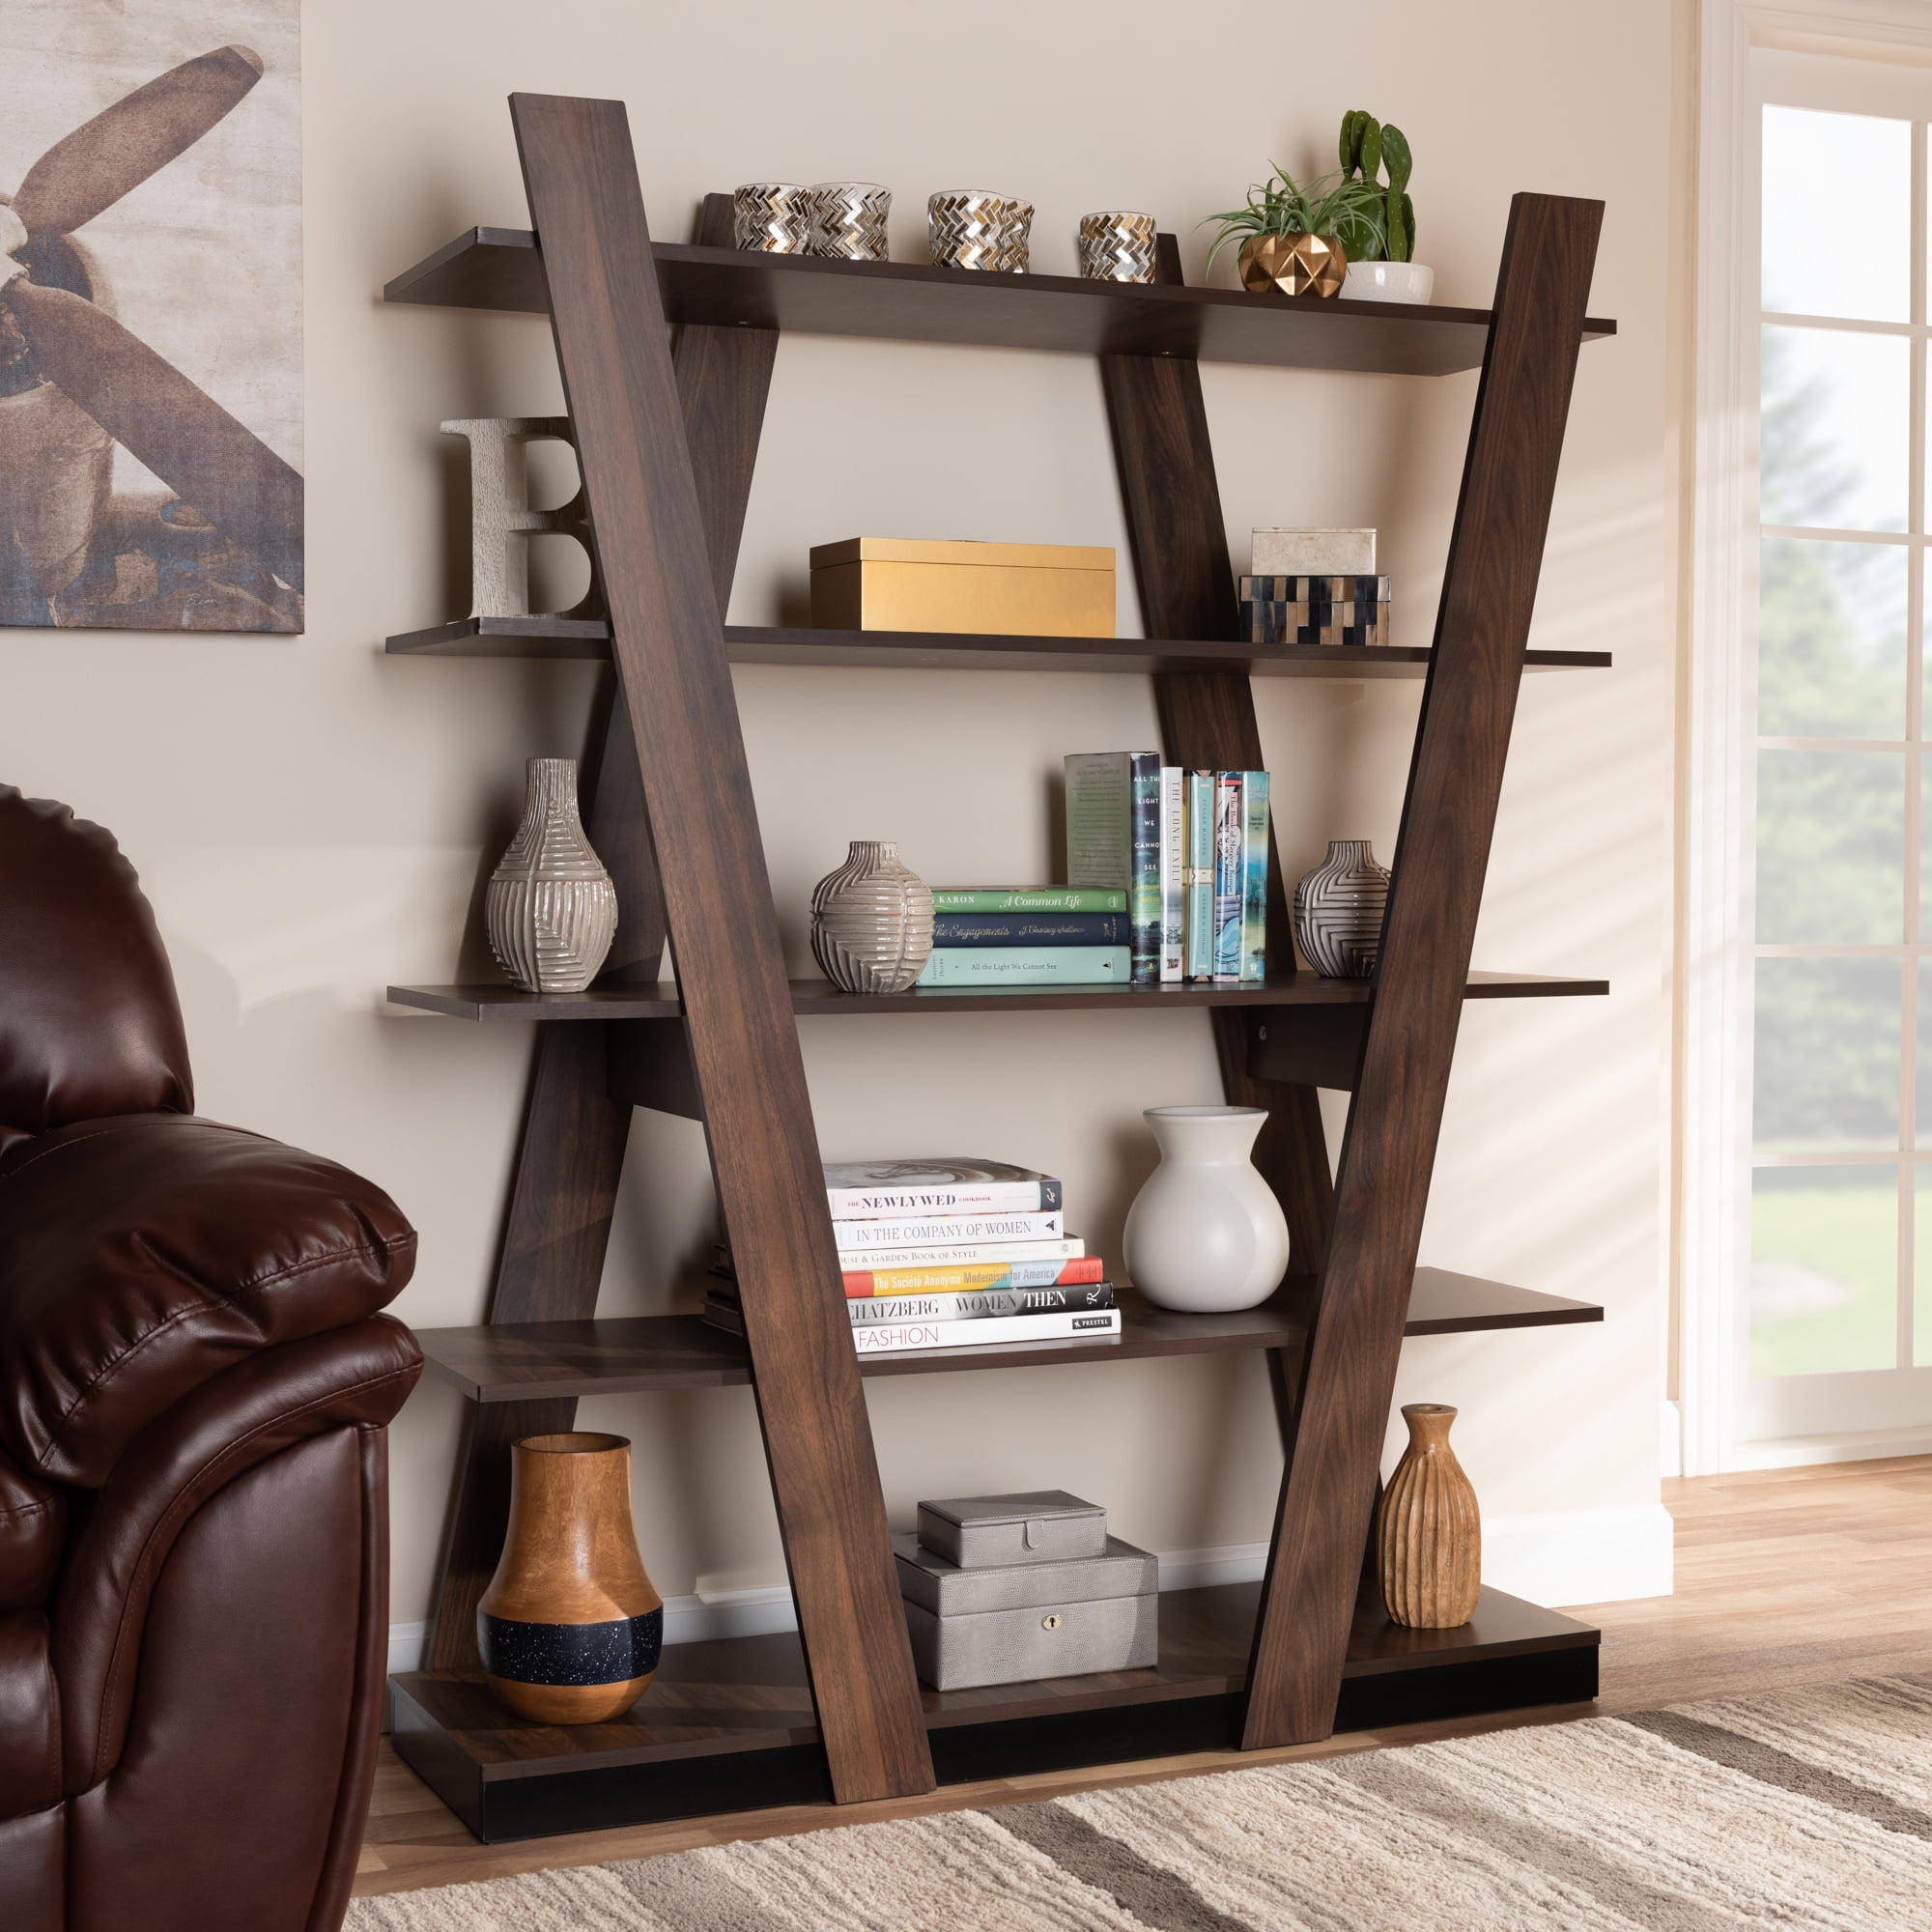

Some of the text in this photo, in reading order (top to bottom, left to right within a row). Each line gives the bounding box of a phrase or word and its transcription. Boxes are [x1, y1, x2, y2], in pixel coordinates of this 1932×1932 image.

[1172, 782, 1180, 885] THE LONG EXILE
[938, 895, 975, 904] KARON
[998, 895, 1083, 909] A Common Life
[935, 923, 1010, 940] The Engagements
[993, 963, 1009, 972] Light
[862, 1194, 956, 1209] NEWLYWED
[857, 1229, 870, 1242] IN
[873, 1227, 900, 1241] THE
[903, 1223, 963, 1239] COMPANY
[966, 1222, 982, 1236] OF
[985, 1221, 1032, 1235] WOMEN
[871, 1254, 909, 1264] GARDEN
[911, 1251, 936, 1261] BOOK
[952, 1250, 978, 1260] STYLE
[873, 1267, 1056, 1290] The Société Anonyme Modernism for America
[955, 1294, 1017, 1313] WOMEN
[1023, 1290, 1066, 1308] THEN
[1081, 1318, 1109, 1327] PRESTEL
[858, 1326, 939, 1348] FASHION
